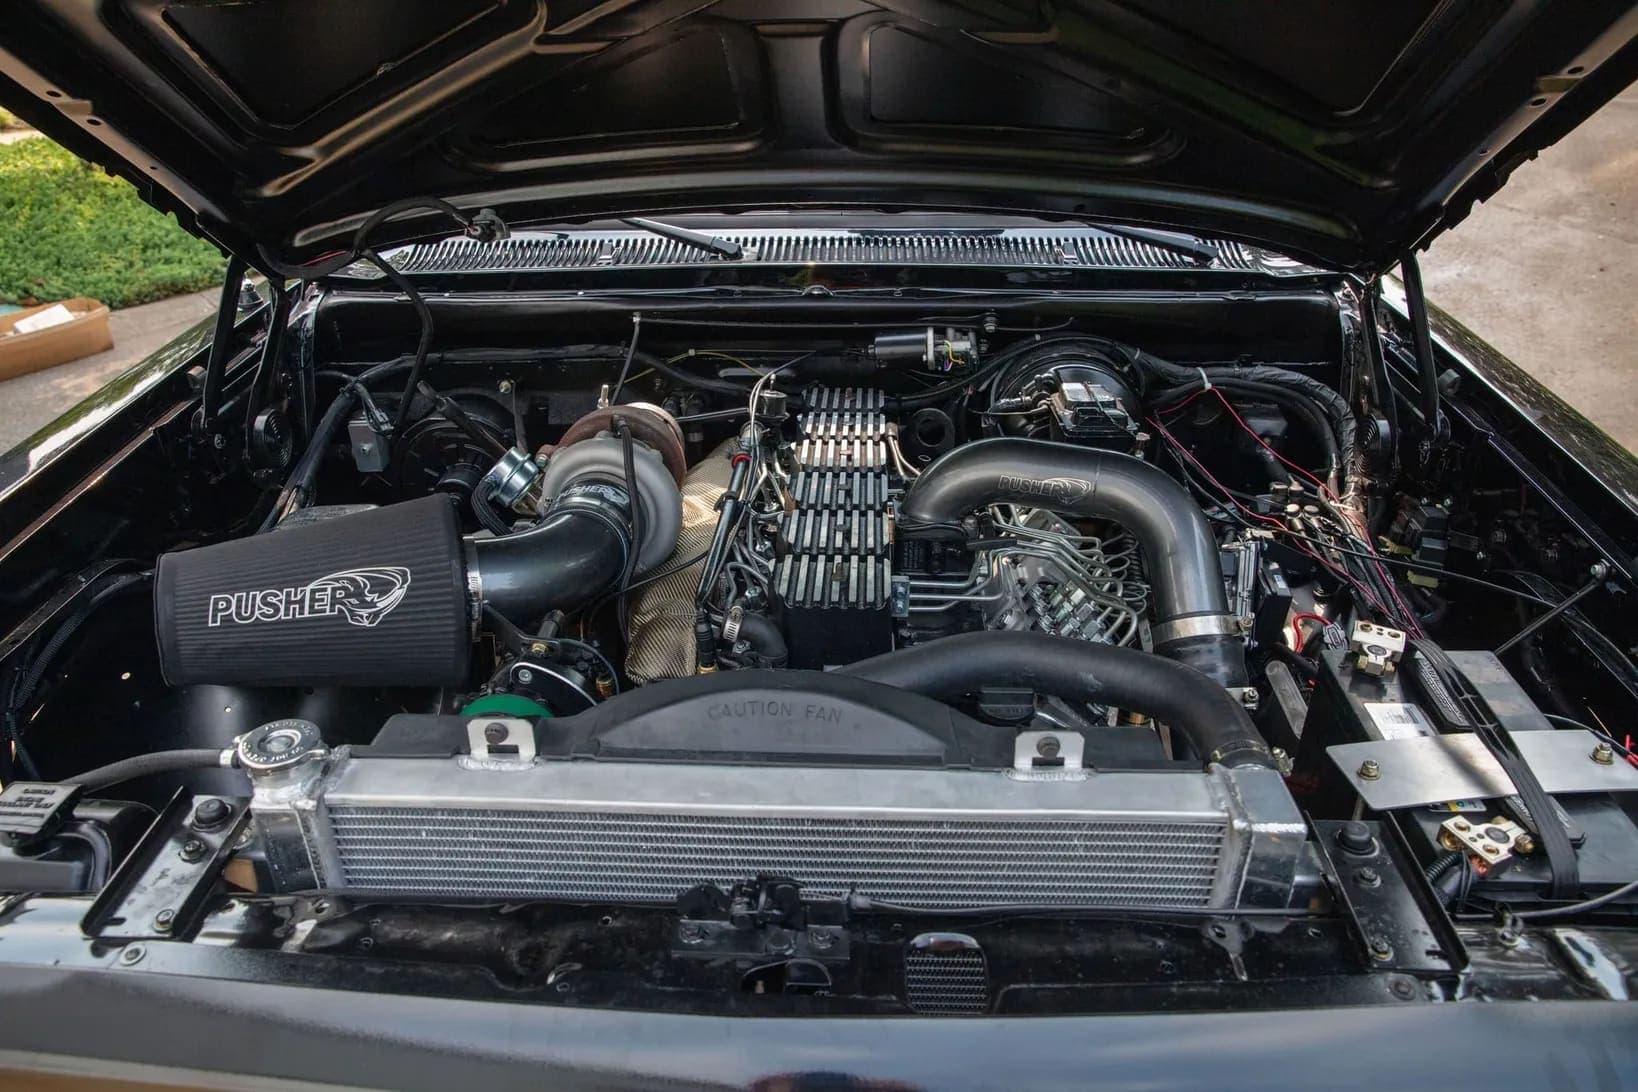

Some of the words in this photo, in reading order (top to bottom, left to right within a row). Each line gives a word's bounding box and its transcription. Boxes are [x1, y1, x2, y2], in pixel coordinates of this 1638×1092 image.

[999, 475, 1066, 497] PUSHER
[208, 585, 353, 626] PUSHER
[707, 700, 792, 721] CAUTION
[805, 704, 842, 723] FAN
